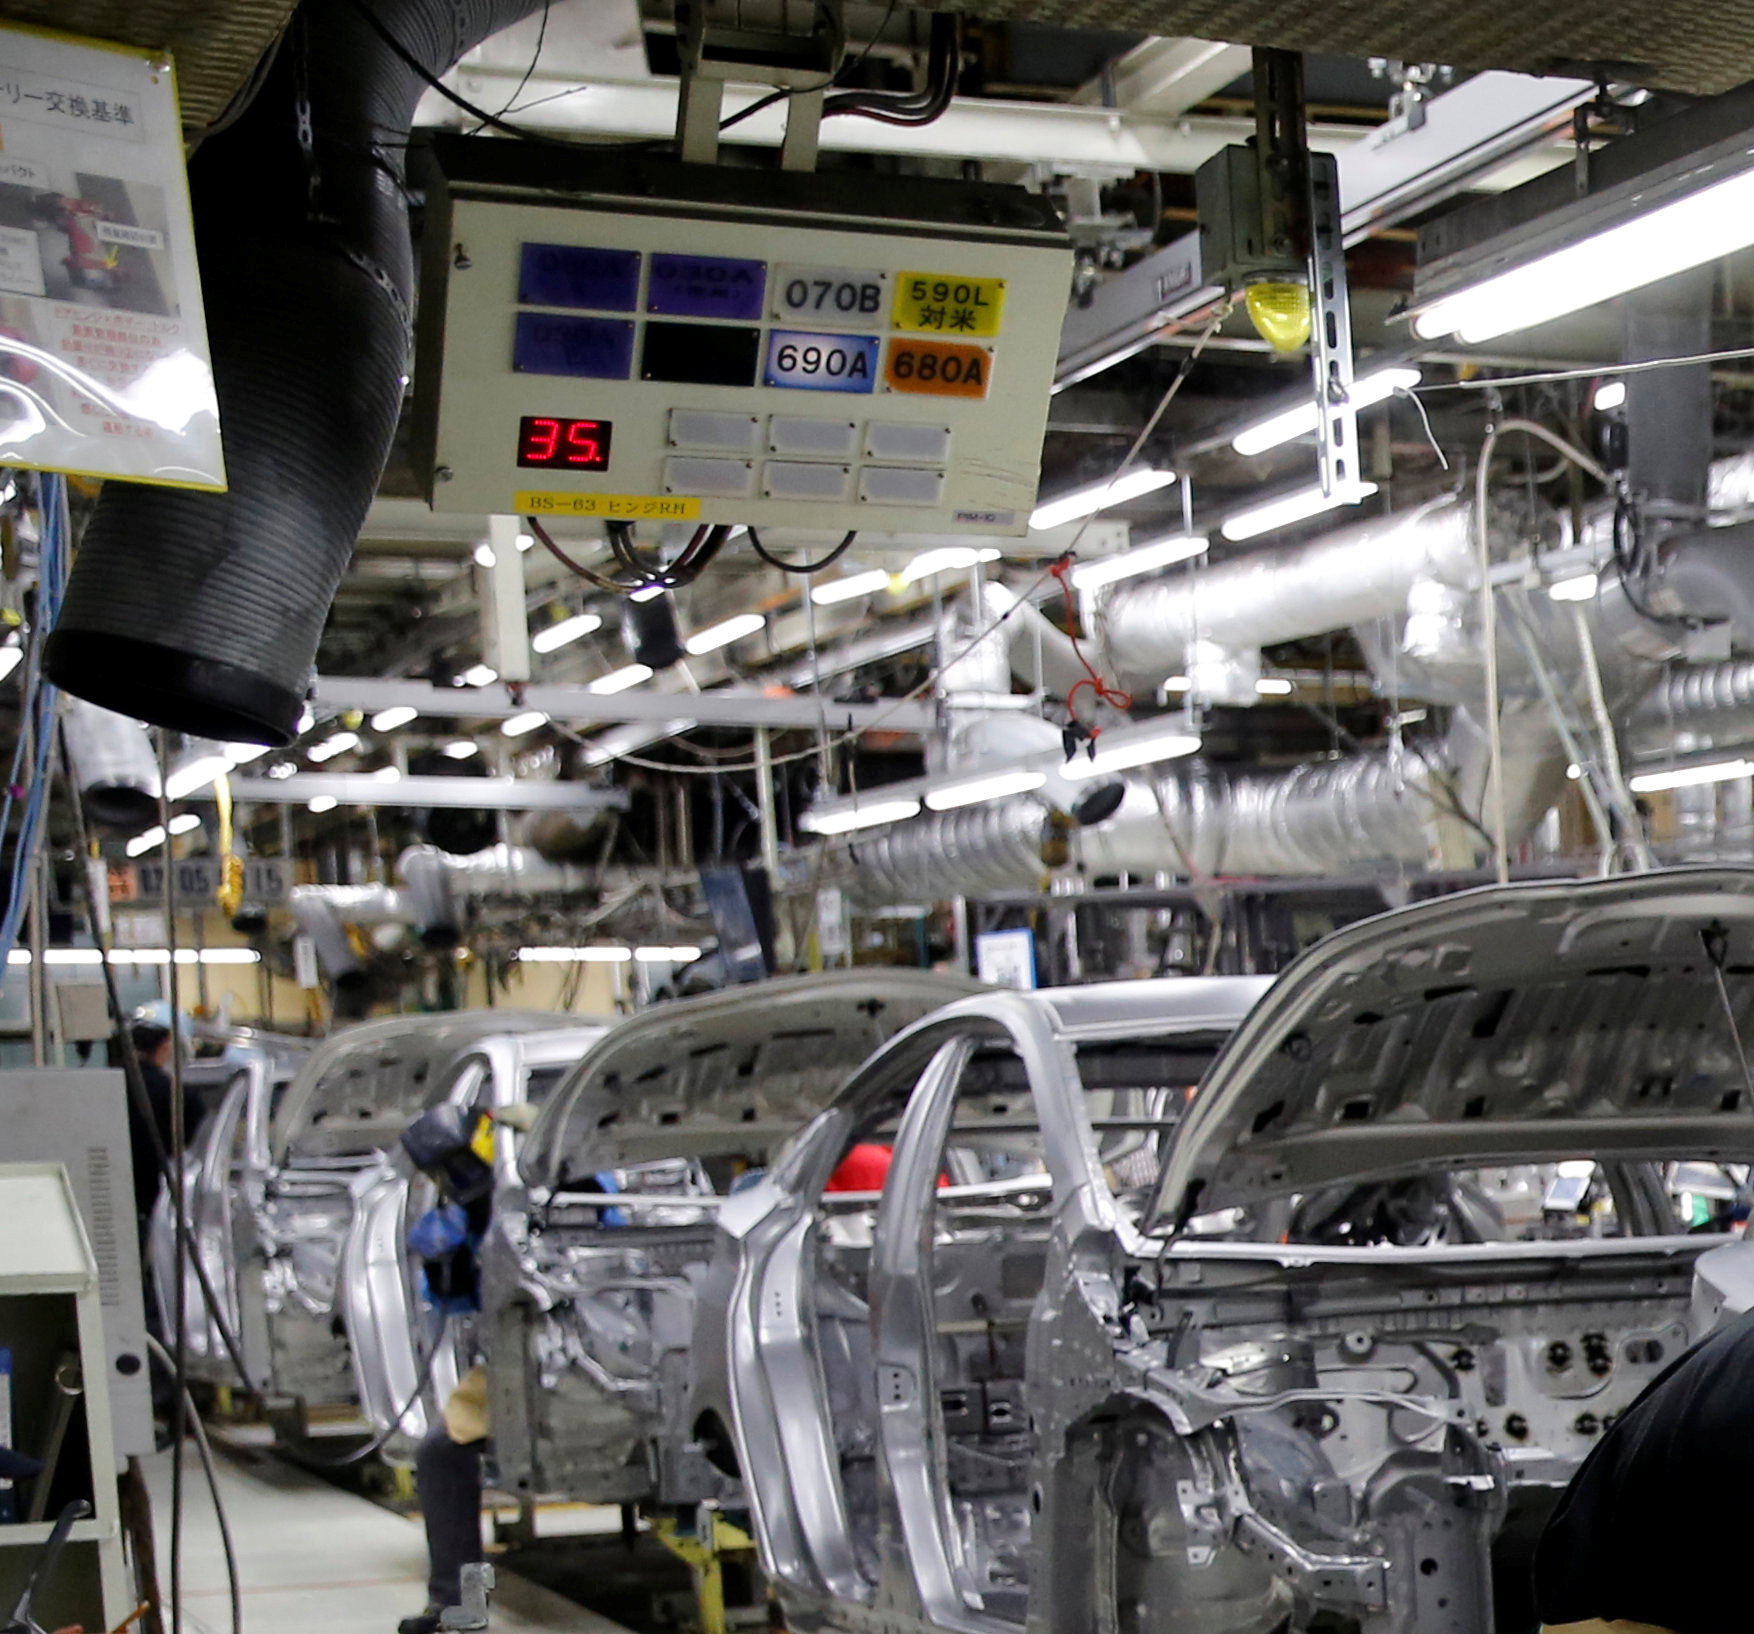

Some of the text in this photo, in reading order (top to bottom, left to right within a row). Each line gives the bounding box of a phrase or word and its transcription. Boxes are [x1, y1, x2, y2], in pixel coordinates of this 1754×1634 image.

[0, 83, 134, 126] リー交換基準
[785, 279, 881, 314] 070B
[911, 281, 989, 307] 590L
[919, 305, 977, 332] 対米
[777, 344, 868, 379] 690A
[893, 351, 983, 386] 680A
